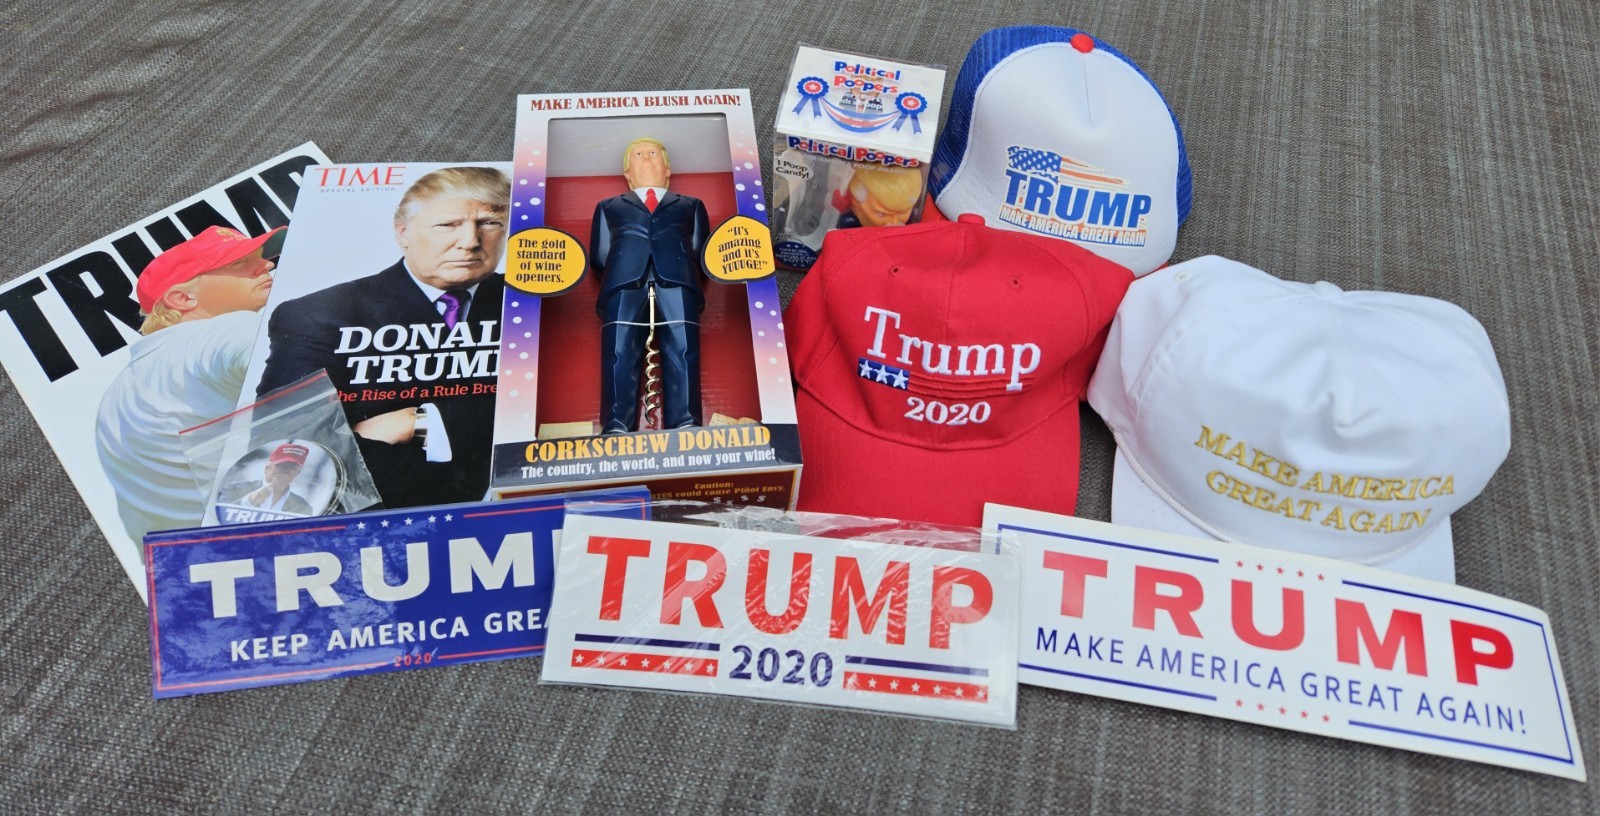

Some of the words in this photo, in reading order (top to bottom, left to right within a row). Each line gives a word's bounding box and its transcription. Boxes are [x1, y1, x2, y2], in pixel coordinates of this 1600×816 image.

[834, 60, 901, 81] Political
[833, 75, 898, 94] Poopers
[530, 98, 572, 111] MAKE
[576, 97, 640, 109] AMERICA
[643, 95, 690, 107] BLUSH
[693, 94, 741, 106] AGAIN!
[787, 135, 852, 159] Political
[855, 147, 919, 167] Poopers
[314, 166, 407, 186] TIME
[775, 166, 810, 179] Candy!
[783, 160, 808, 172] Poop
[1005, 168, 1152, 229] TRUMP
[1000, 205, 1029, 228] MAKE
[1029, 216, 1079, 239] AMERICA
[1080, 226, 1117, 243] GREAT
[1115, 230, 1146, 245] AGAIN
[517, 238, 538, 248] The
[541, 238, 566, 249] gold
[718, 237, 762, 253] amazing
[516, 249, 566, 260] standard
[722, 248, 741, 262] and
[520, 260, 532, 271] of
[535, 260, 562, 271] wine
[515, 272, 565, 283] openers.
[864, 305, 1042, 391] Trump
[361, 389, 397, 401] Rise
[400, 386, 418, 399] of
[419, 388, 429, 398] a
[433, 384, 469, 397] Rule
[904, 396, 992, 426] 2020
[525, 432, 670, 463] CORKSCREW
[678, 425, 771, 451] DONALD
[520, 465, 544, 479] The
[546, 462, 596, 475] country,
[598, 459, 618, 473] the
[621, 456, 659, 470] world,
[662, 455, 685, 468] and
[688, 454, 712, 466] now
[715, 452, 742, 465] your
[744, 447, 776, 462] wine!
[1194, 425, 1300, 488] MAKE
[1299, 471, 1456, 501] AMERICA
[675, 490, 702, 498] could
[704, 488, 731, 496] cause
[1205, 469, 1323, 522] GREAT
[1320, 505, 1433, 533] AGAIN
[587, 536, 994, 650] TRUMP
[1043, 550, 1515, 686] TRUMP
[230, 633, 310, 662] KEEP
[326, 616, 470, 652] AMERICA
[393, 652, 432, 667] 2020
[728, 644, 834, 687] 2020
[1036, 626, 1124, 664] MAKE
[1136, 644, 1286, 692] AMERICA
[1300, 672, 1403, 712] GREAT
[1416, 692, 1526, 735] AGAIN!
